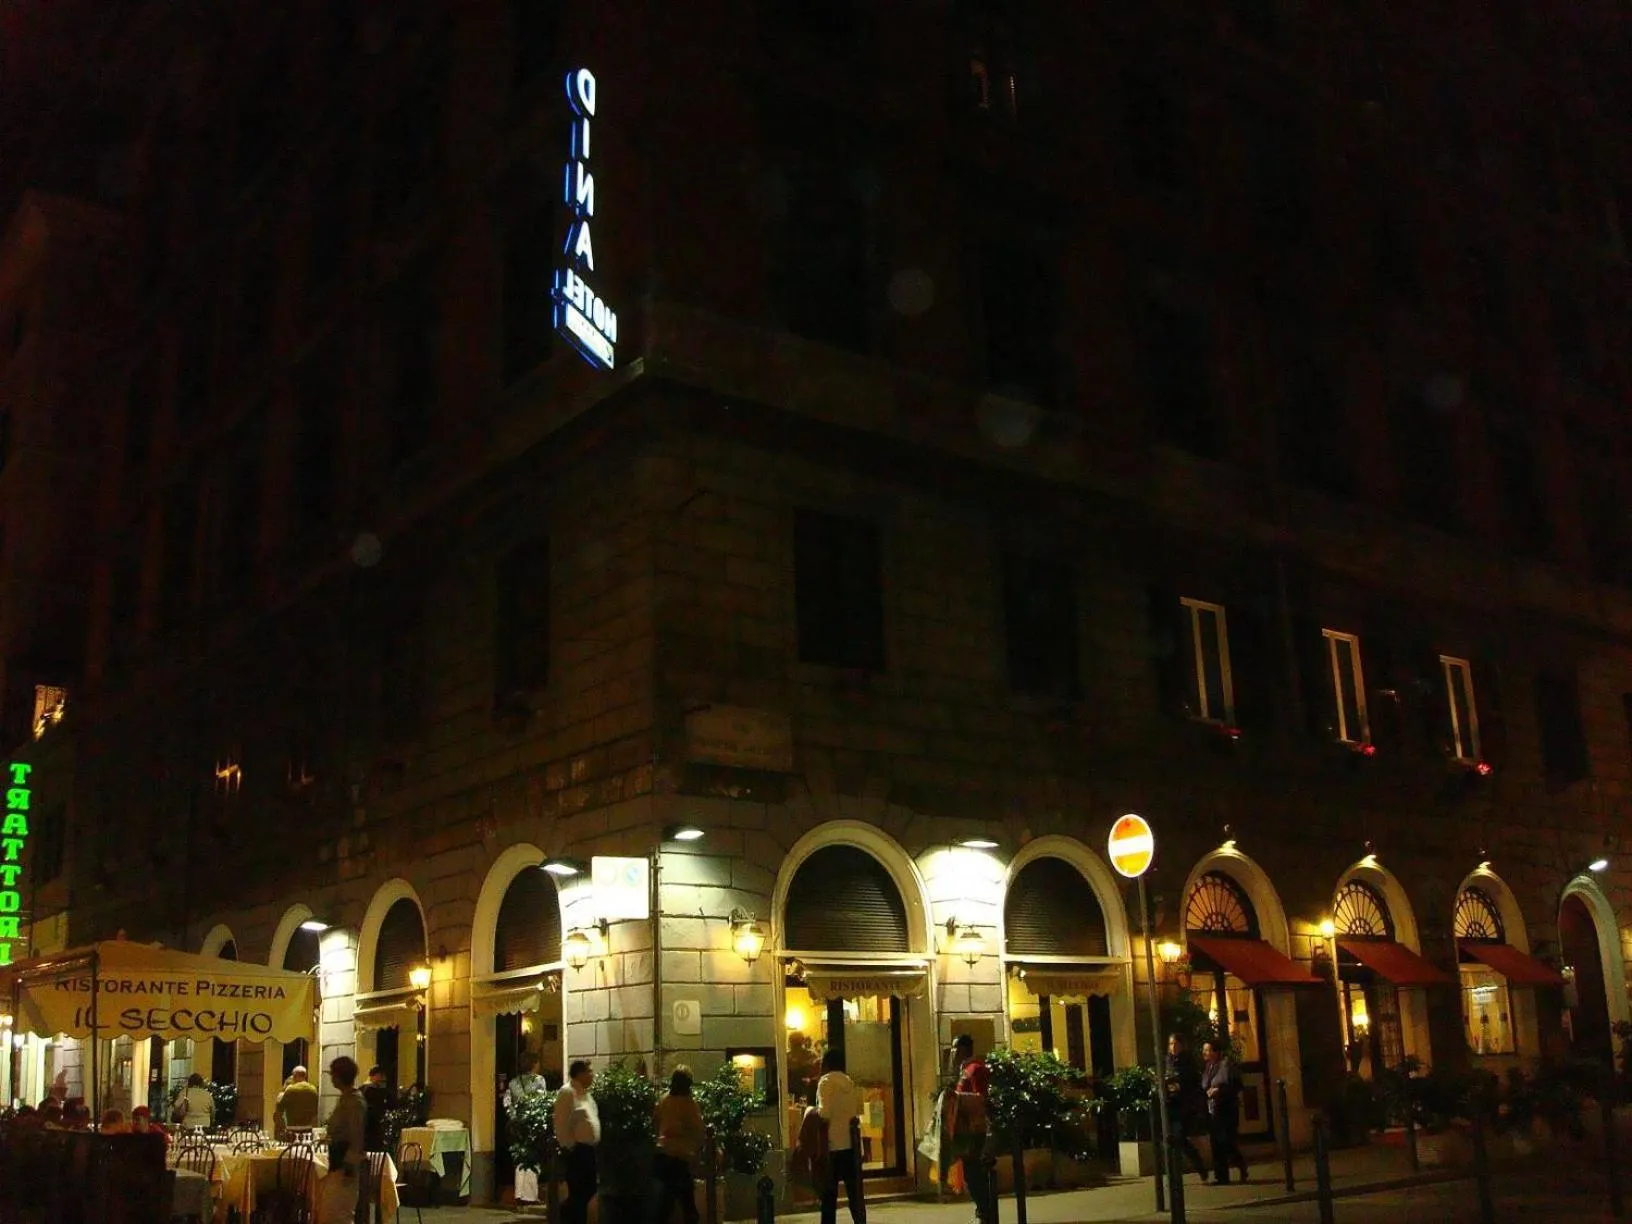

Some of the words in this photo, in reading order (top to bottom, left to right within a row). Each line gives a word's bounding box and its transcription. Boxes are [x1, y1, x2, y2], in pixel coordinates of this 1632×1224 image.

[54, 978, 189, 996] RISTORANTE
[195, 980, 286, 999] PIZZERIA
[74, 1005, 110, 1029] IL
[118, 1007, 273, 1034] SECCHIO
